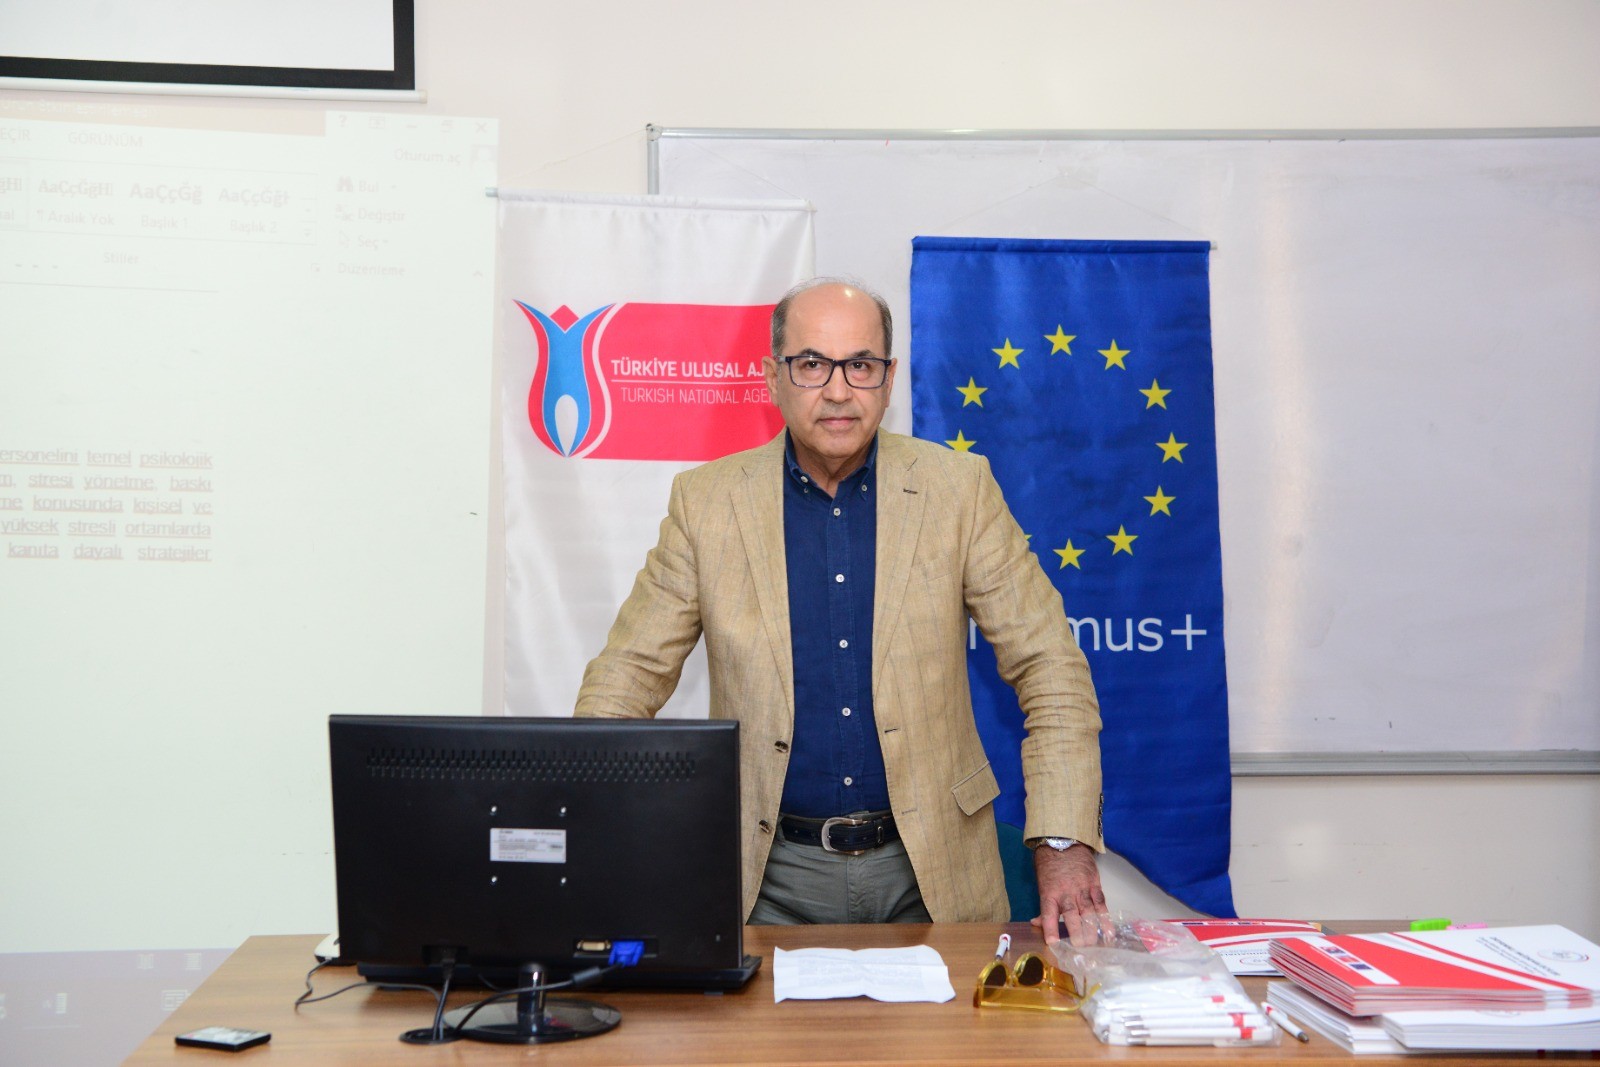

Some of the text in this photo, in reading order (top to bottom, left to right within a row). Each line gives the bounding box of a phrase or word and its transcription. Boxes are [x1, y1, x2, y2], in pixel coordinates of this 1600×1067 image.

[611, 357, 677, 377] TÜRKİYE
[681, 362, 743, 378] ULUSAL
[621, 387, 674, 403] TURKISH
[679, 389, 739, 405] NATIONAL
[87, 449, 131, 466] temel
[33, 494, 123, 513] konusunda
